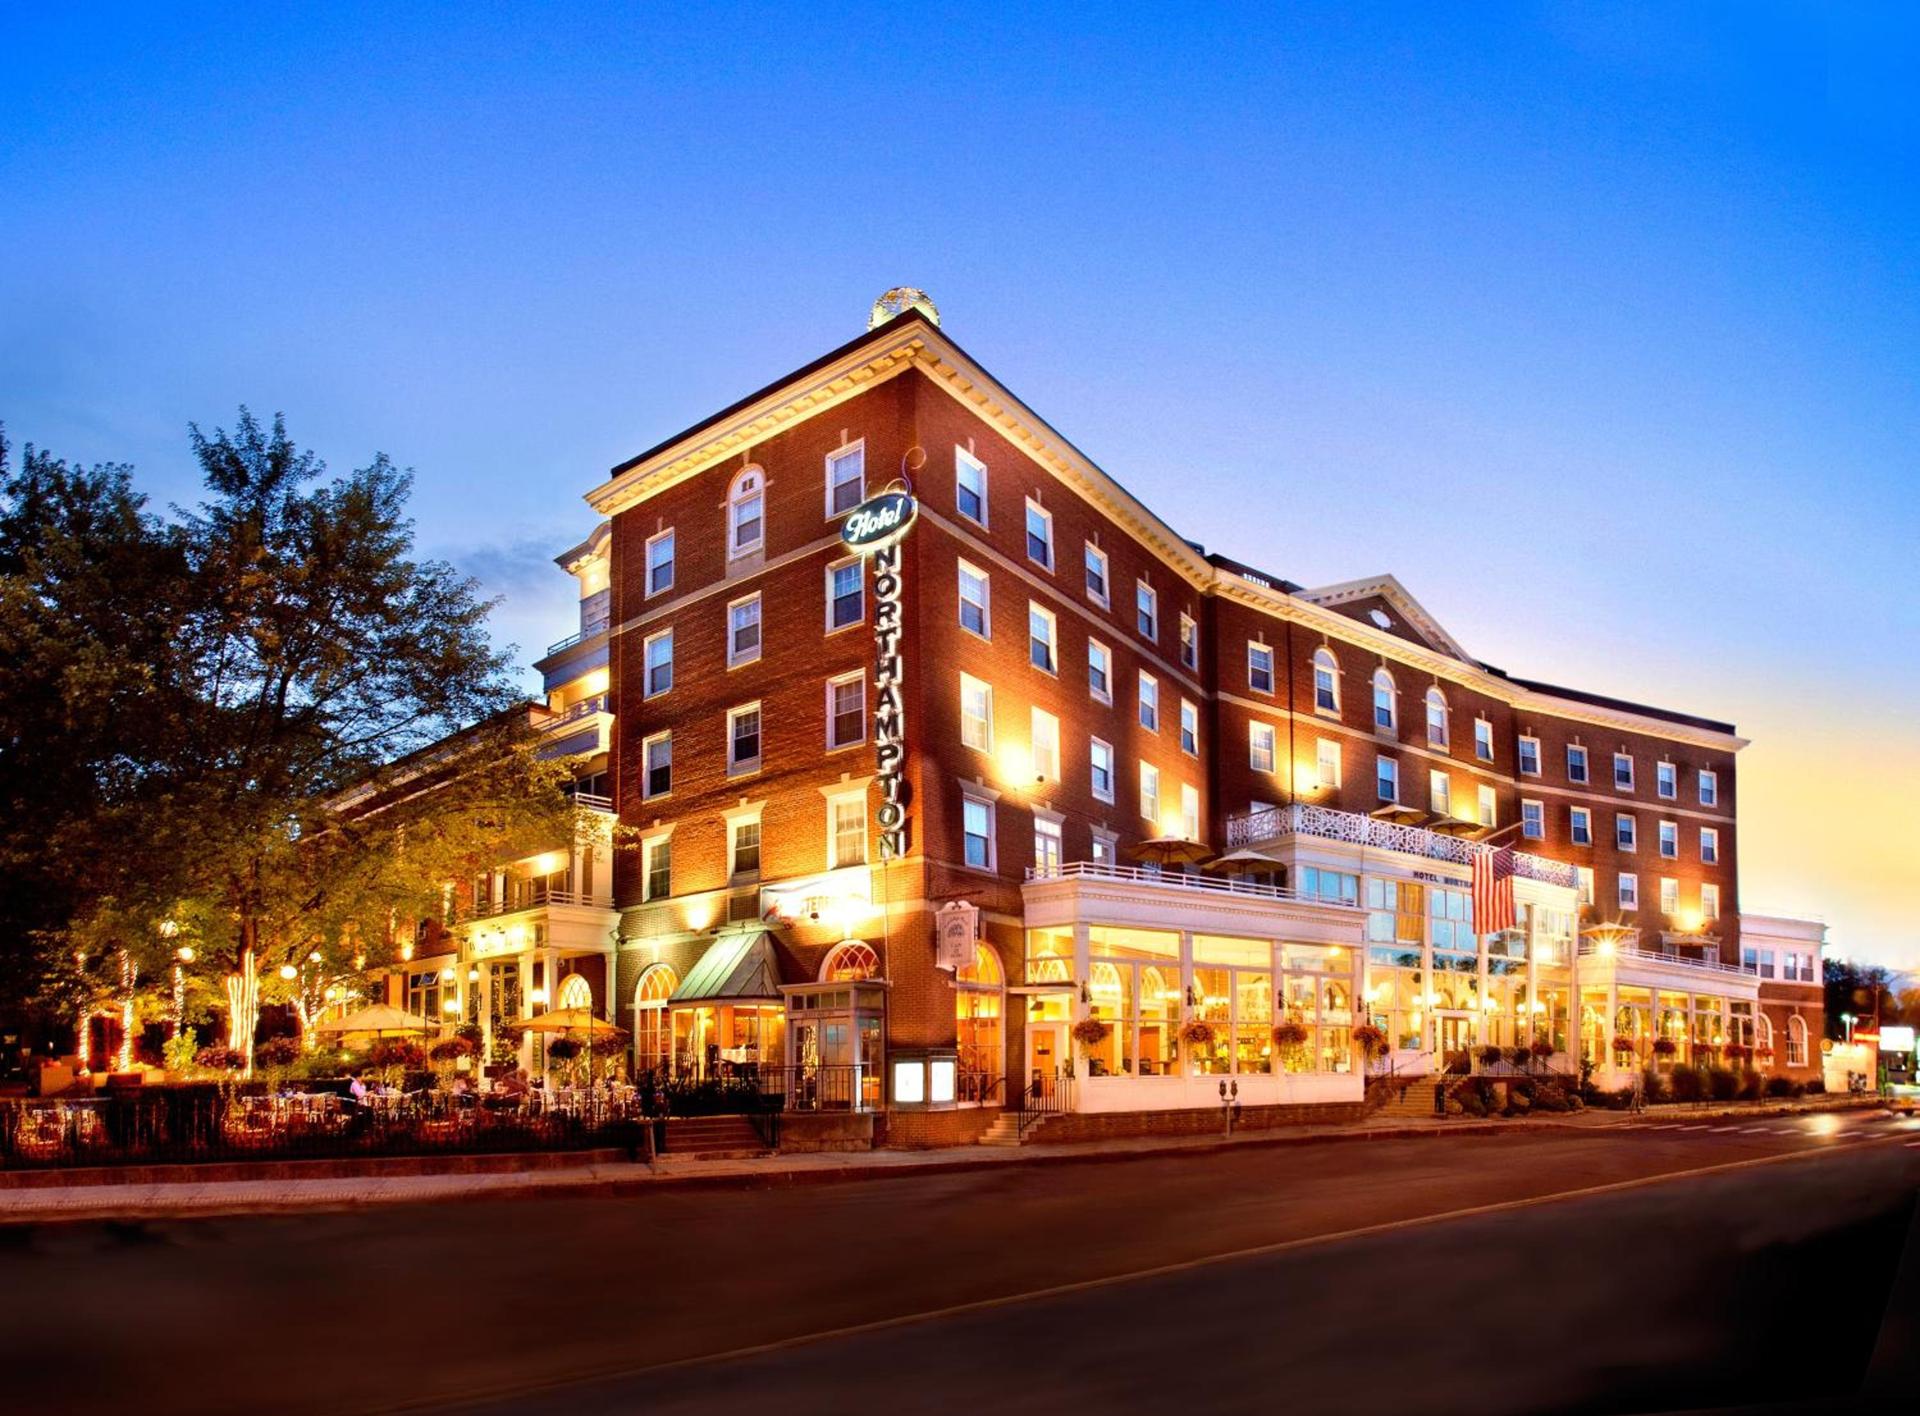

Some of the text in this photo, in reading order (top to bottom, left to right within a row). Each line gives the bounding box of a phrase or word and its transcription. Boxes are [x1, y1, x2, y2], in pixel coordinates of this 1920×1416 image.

[846, 497, 905, 542] Hotel
[874, 544, 904, 860] NORTHAMPTON
[1413, 871, 1439, 882] HOTEL
